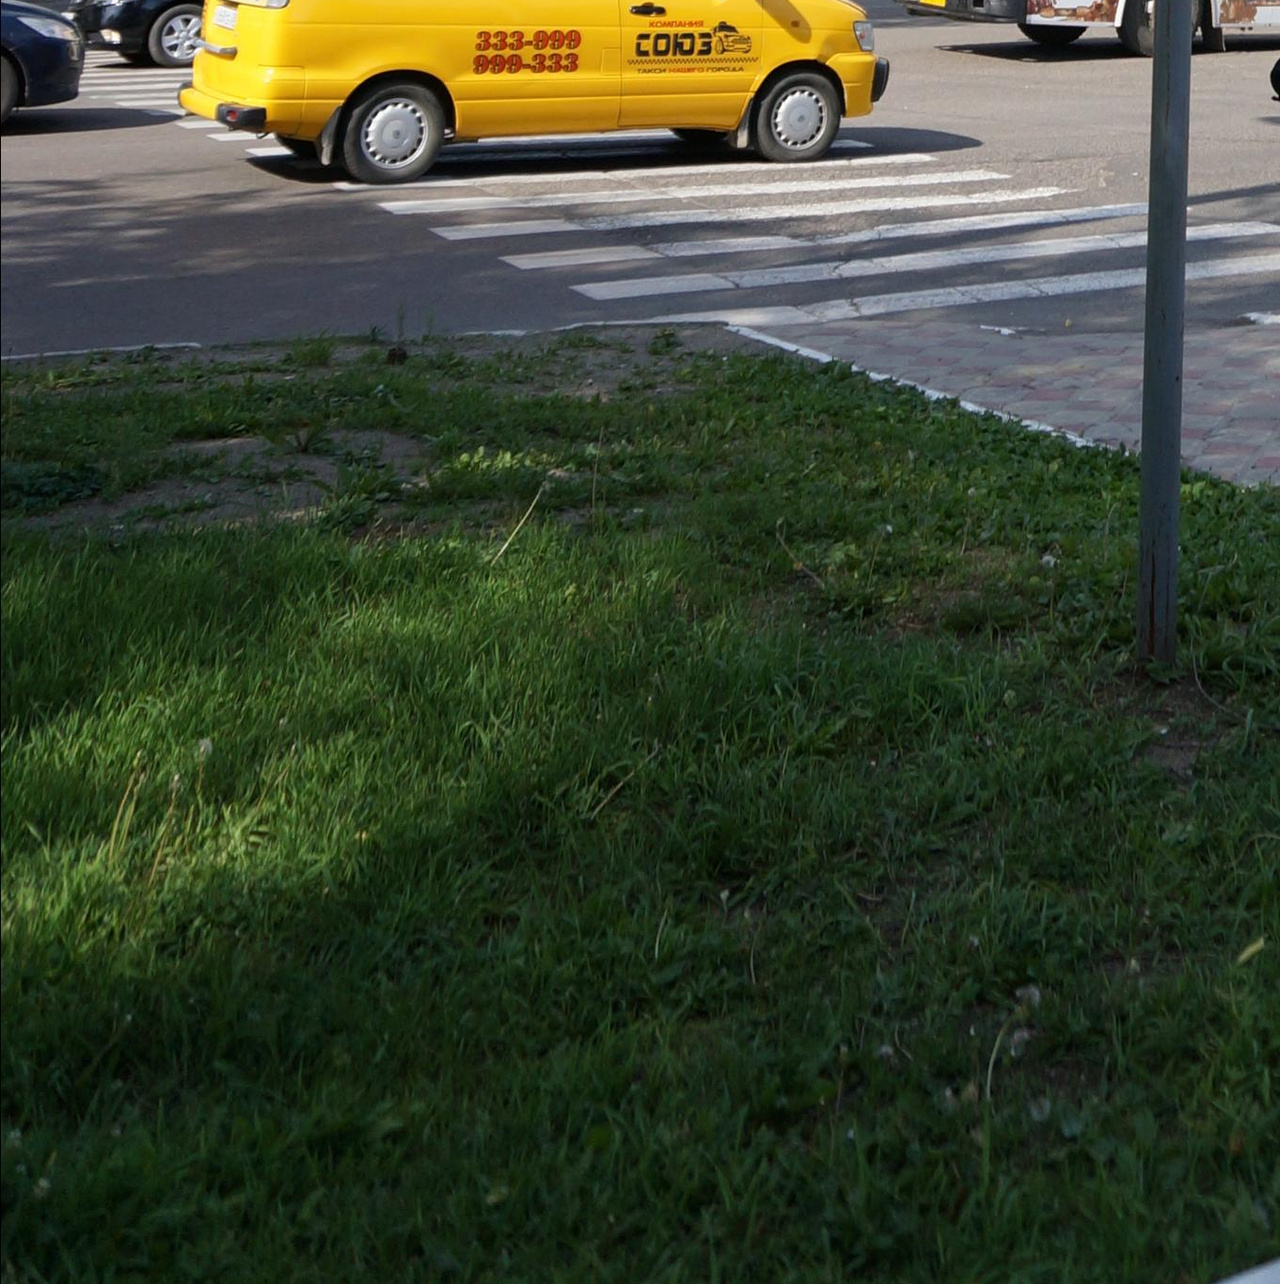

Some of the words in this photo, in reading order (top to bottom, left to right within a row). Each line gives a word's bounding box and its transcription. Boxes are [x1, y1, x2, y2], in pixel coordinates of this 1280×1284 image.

[649, 20, 704, 28] КОМПАНИЯ
[475, 29, 581, 52] 333-999
[635, 32, 712, 57] СОЮЗ
[473, 53, 579, 75] 999-333
[668, 66, 705, 74] НАШЕГО
